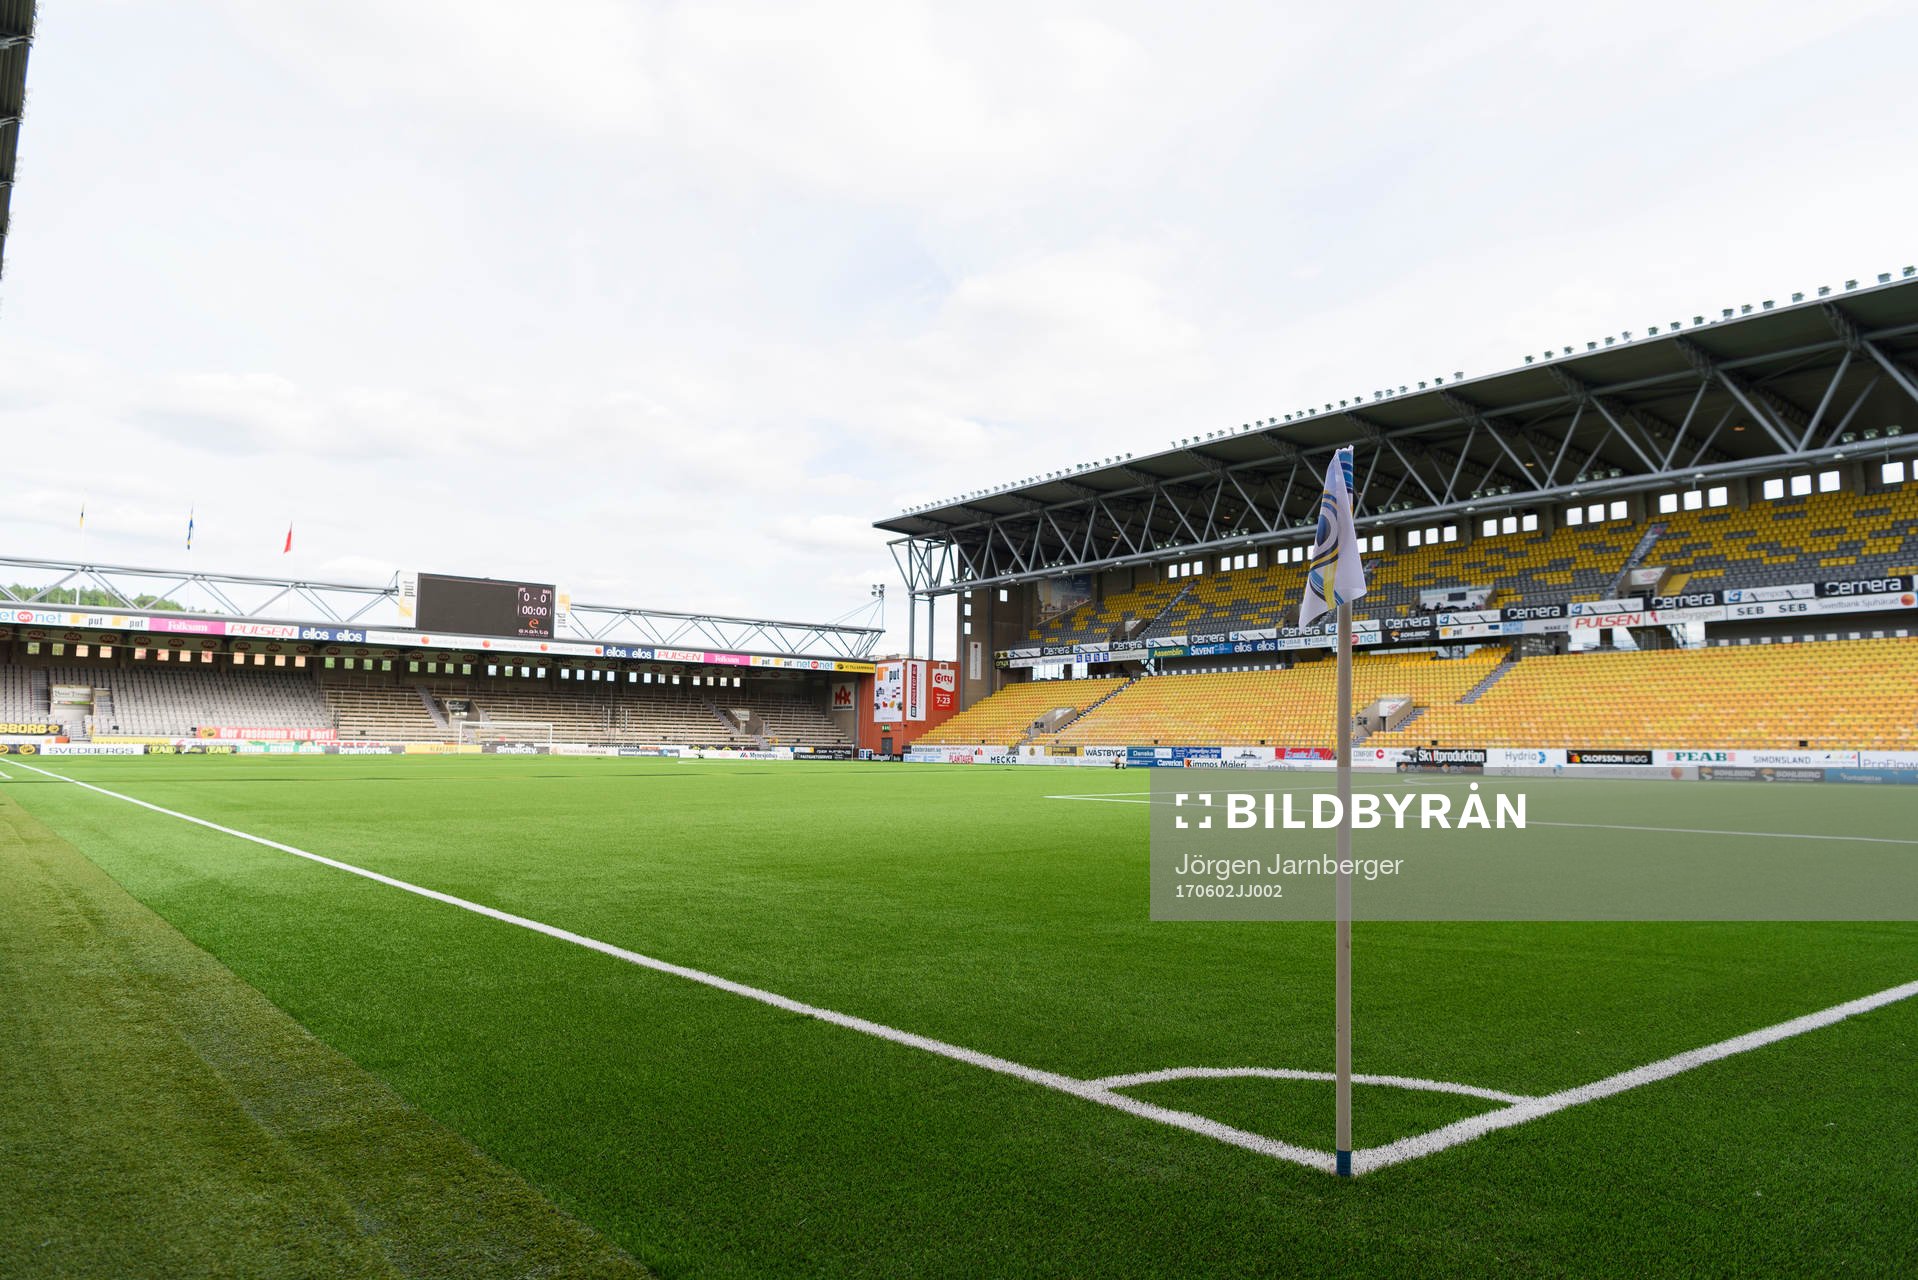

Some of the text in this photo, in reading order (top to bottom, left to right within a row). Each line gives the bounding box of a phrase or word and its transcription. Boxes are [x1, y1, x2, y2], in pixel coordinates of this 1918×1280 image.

[523, 592, 530, 602] 0
[540, 594, 547, 603] 0
[521, 605, 547, 616] 00:00
[1737, 606, 1765, 616] SEB
[1778, 603, 1808, 614] SEB
[1575, 613, 1641, 629] PULSEN
[230, 623, 295, 637] PULSEN
[302, 628, 329, 640] ellos
[336, 629, 363, 642] ellos
[1234, 642, 1252, 653] ellos
[1256, 641, 1275, 651] ellos
[606, 647, 627, 658] ellos
[631, 649, 652, 660] ellos
[657, 651, 702, 661] PULSEN
[990, 755, 1017, 764] MECKA
[1582, 753, 1624, 763] OLOFSSON
[1675, 751, 1728, 762] PEAB
[1753, 755, 1812, 765] SIMONSLAND
[1187, 758, 1218, 768] Kimmos
